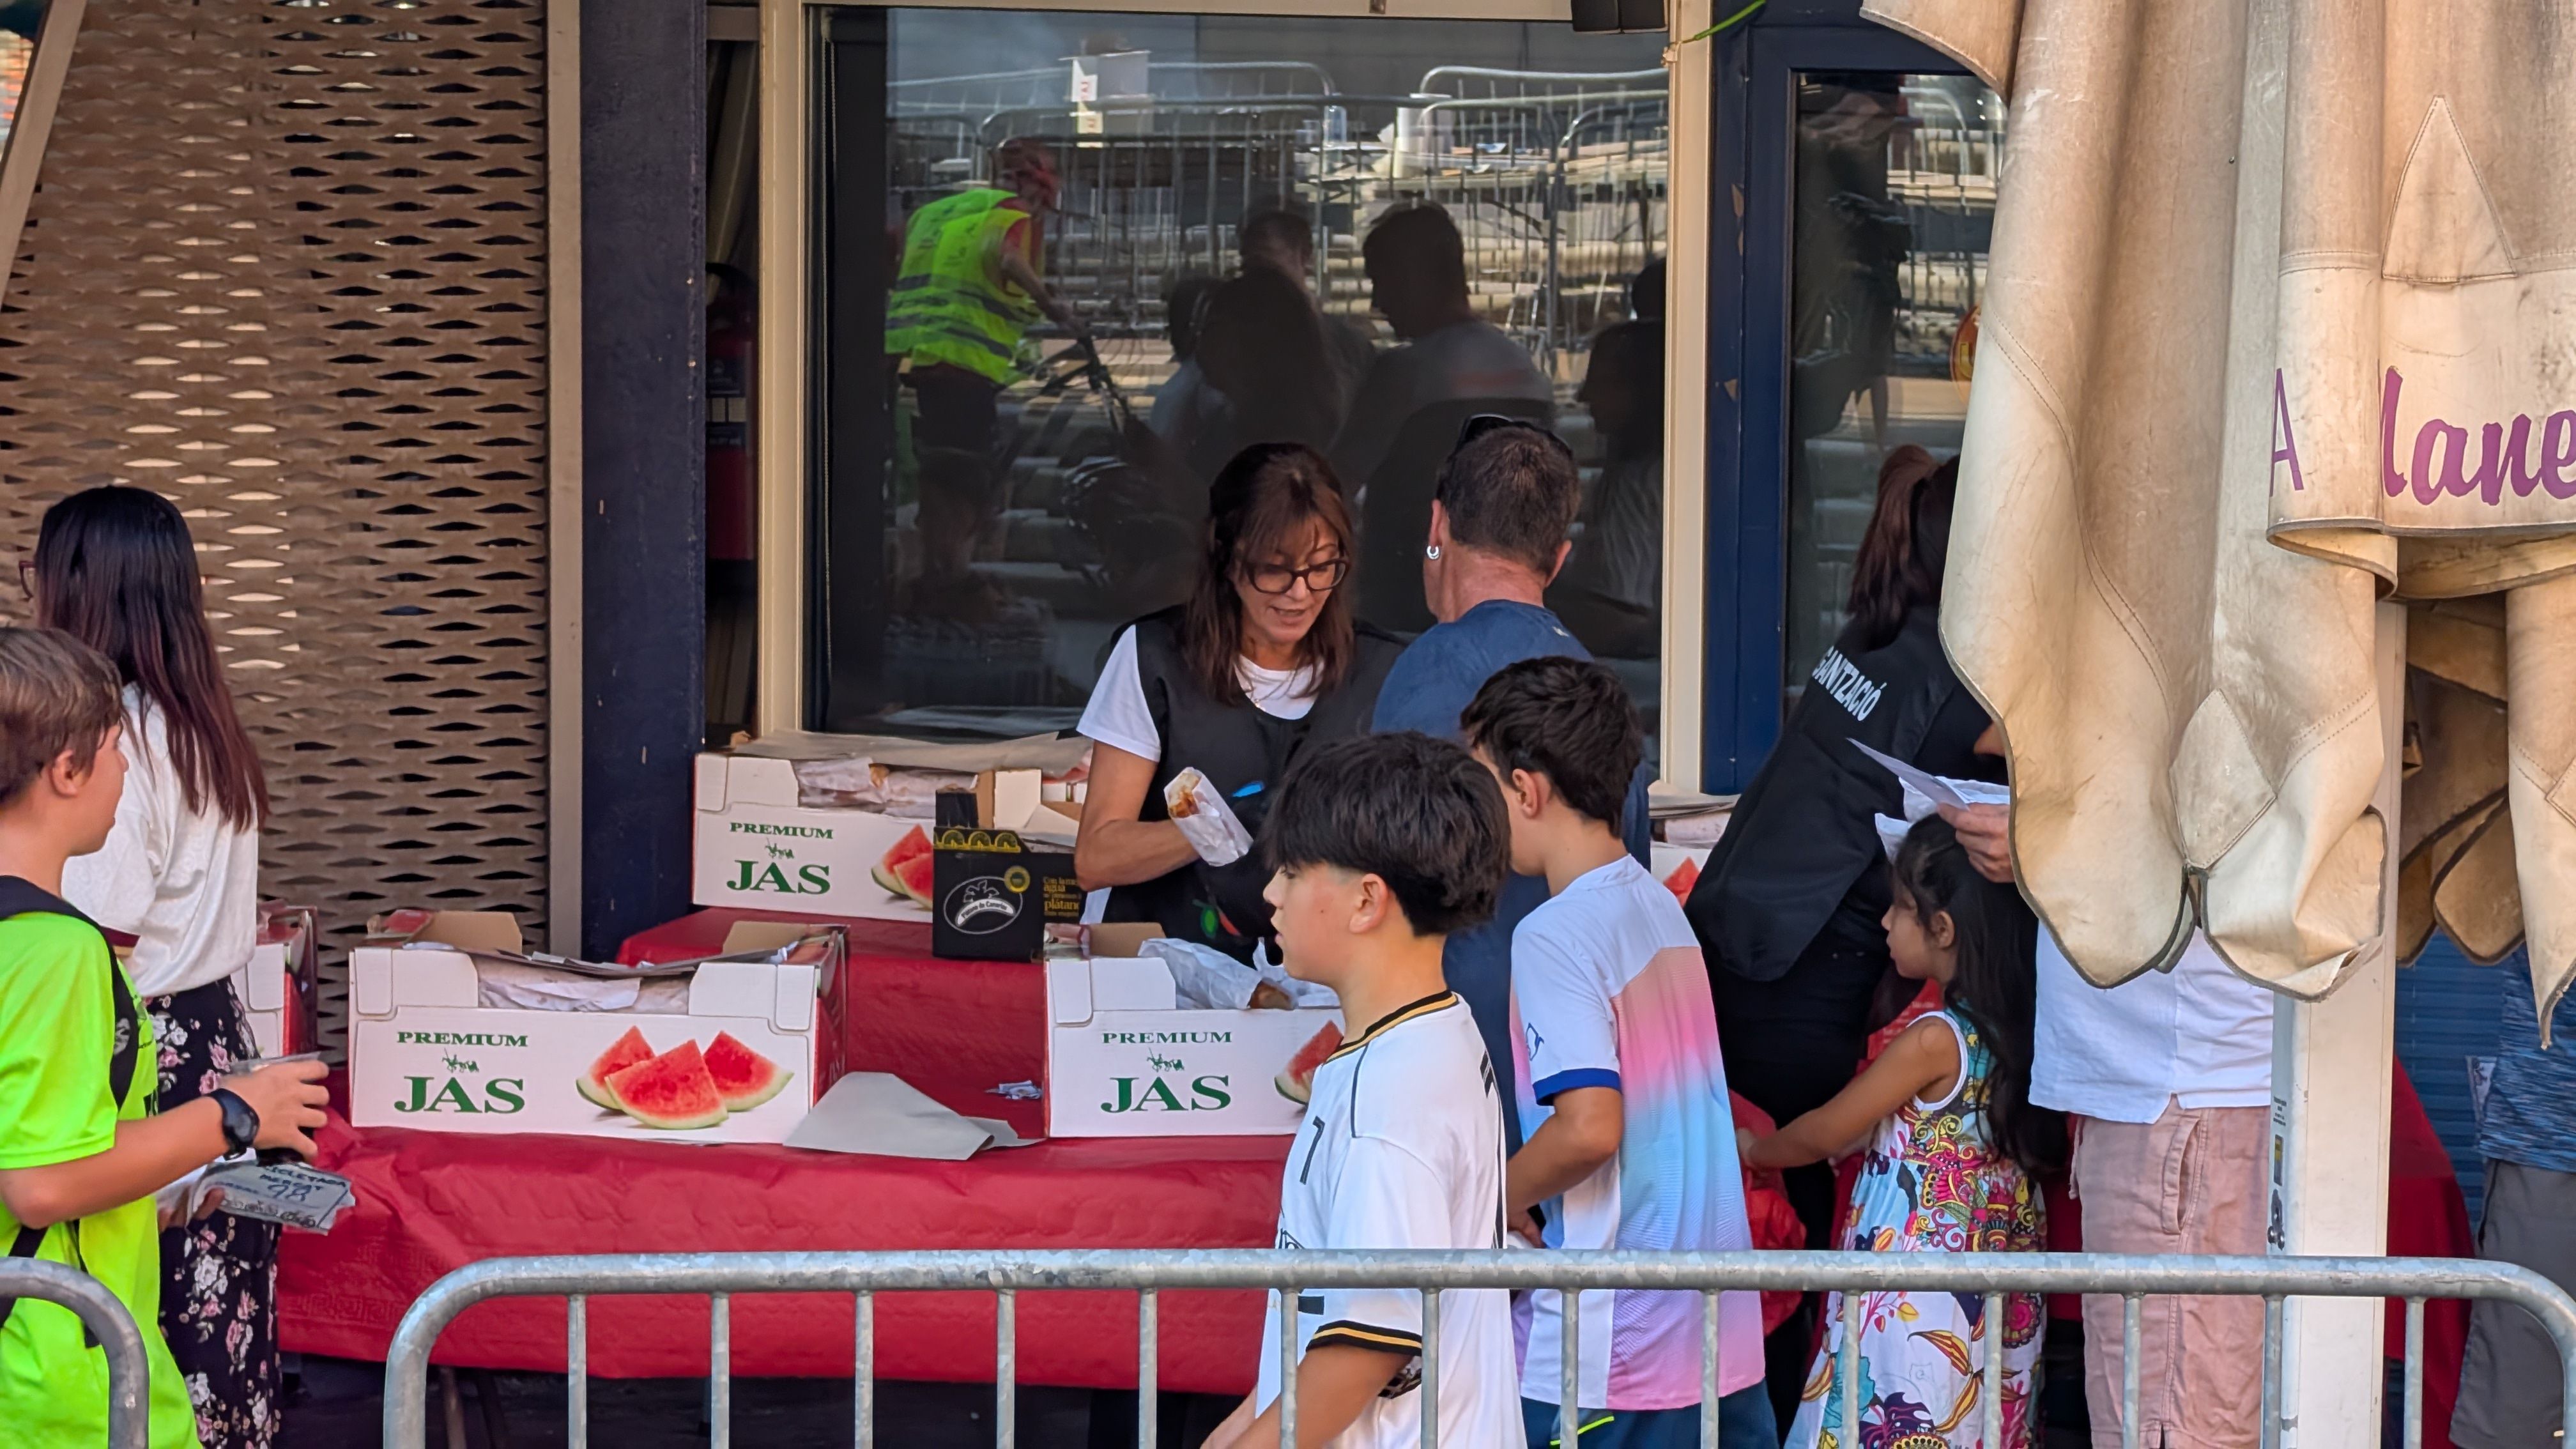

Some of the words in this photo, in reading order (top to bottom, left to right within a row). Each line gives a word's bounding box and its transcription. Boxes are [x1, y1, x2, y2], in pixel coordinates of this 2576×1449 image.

[730, 822, 833, 839] PREMIUM
[726, 860, 831, 894] JAS
[397, 1031, 528, 1046] PREMIUM
[1101, 1031, 1232, 1043] PREMIUM
[394, 1076, 525, 1114] JAS
[1100, 1075, 1231, 1113] JAS
